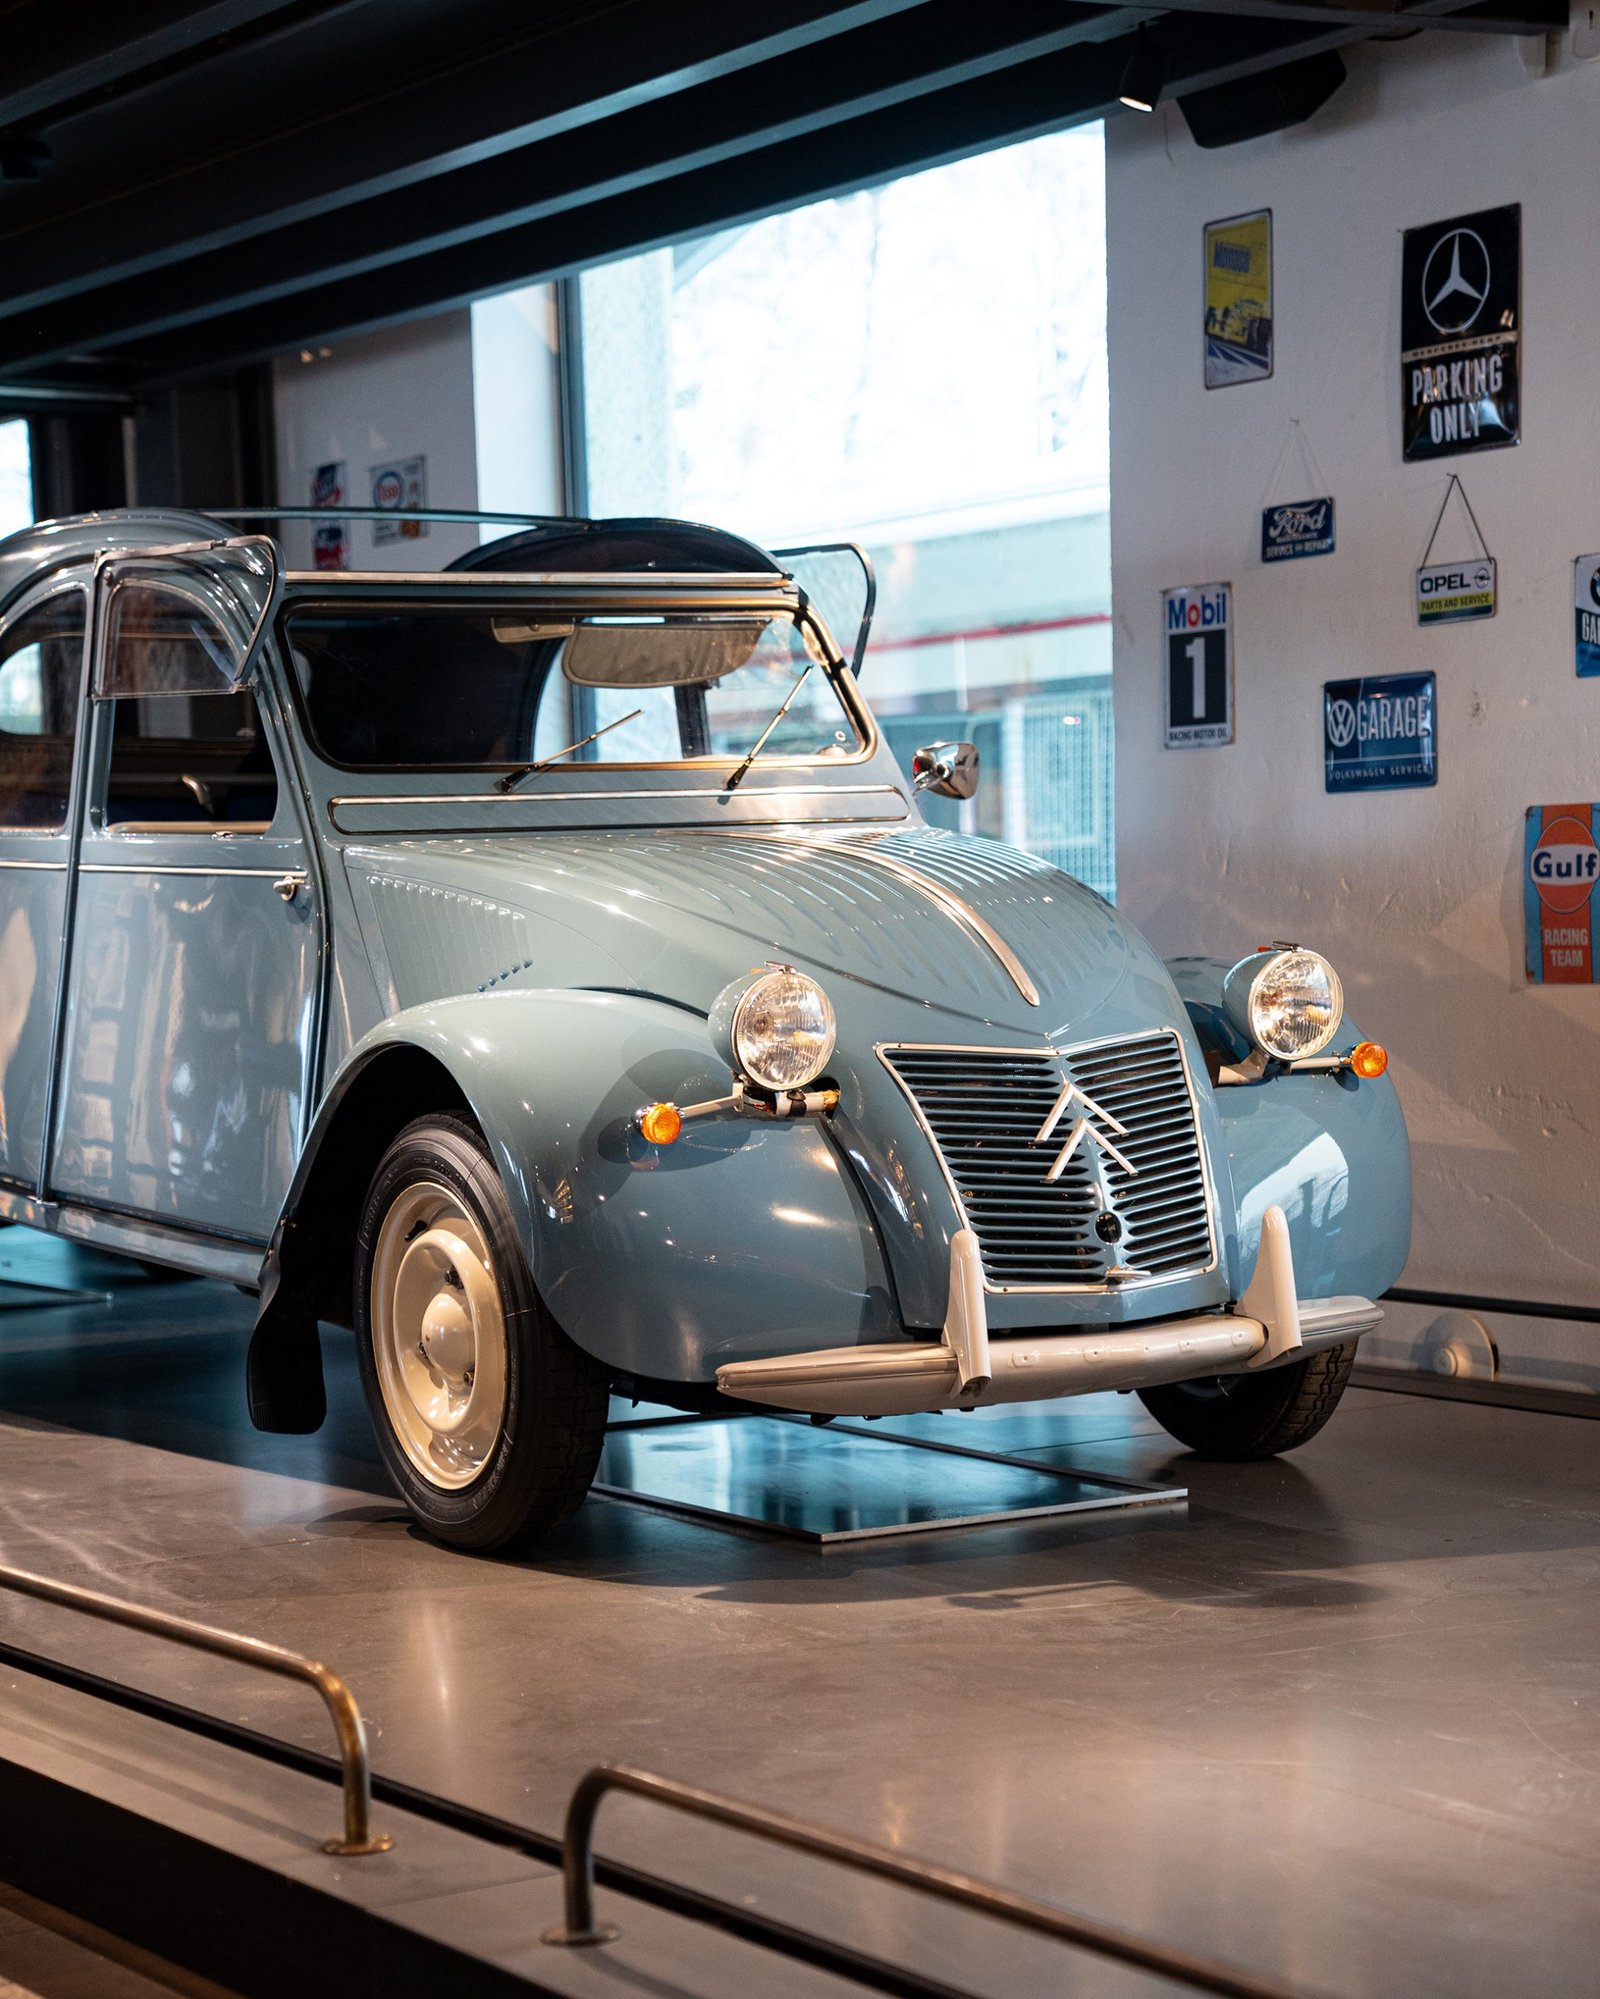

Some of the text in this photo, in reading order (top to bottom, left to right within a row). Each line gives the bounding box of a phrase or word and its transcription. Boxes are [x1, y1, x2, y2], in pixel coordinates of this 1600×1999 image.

[1412, 354, 1503, 406] PARKING
[1430, 401, 1481, 445] ONLY
[1269, 502, 1327, 538] Ford
[1420, 573, 1470, 594] OPEL
[1460, 592, 1489, 606] SERVICE
[1168, 593, 1226, 629] Mobil
[1582, 612, 1600, 646] GA
[1185, 637, 1205, 719] 1
[1357, 696, 1430, 741] GARAGE
[1533, 852, 1597, 878] Gulf
[1544, 928, 1588, 946] RACING
[1551, 950, 1583, 967] TEAM
